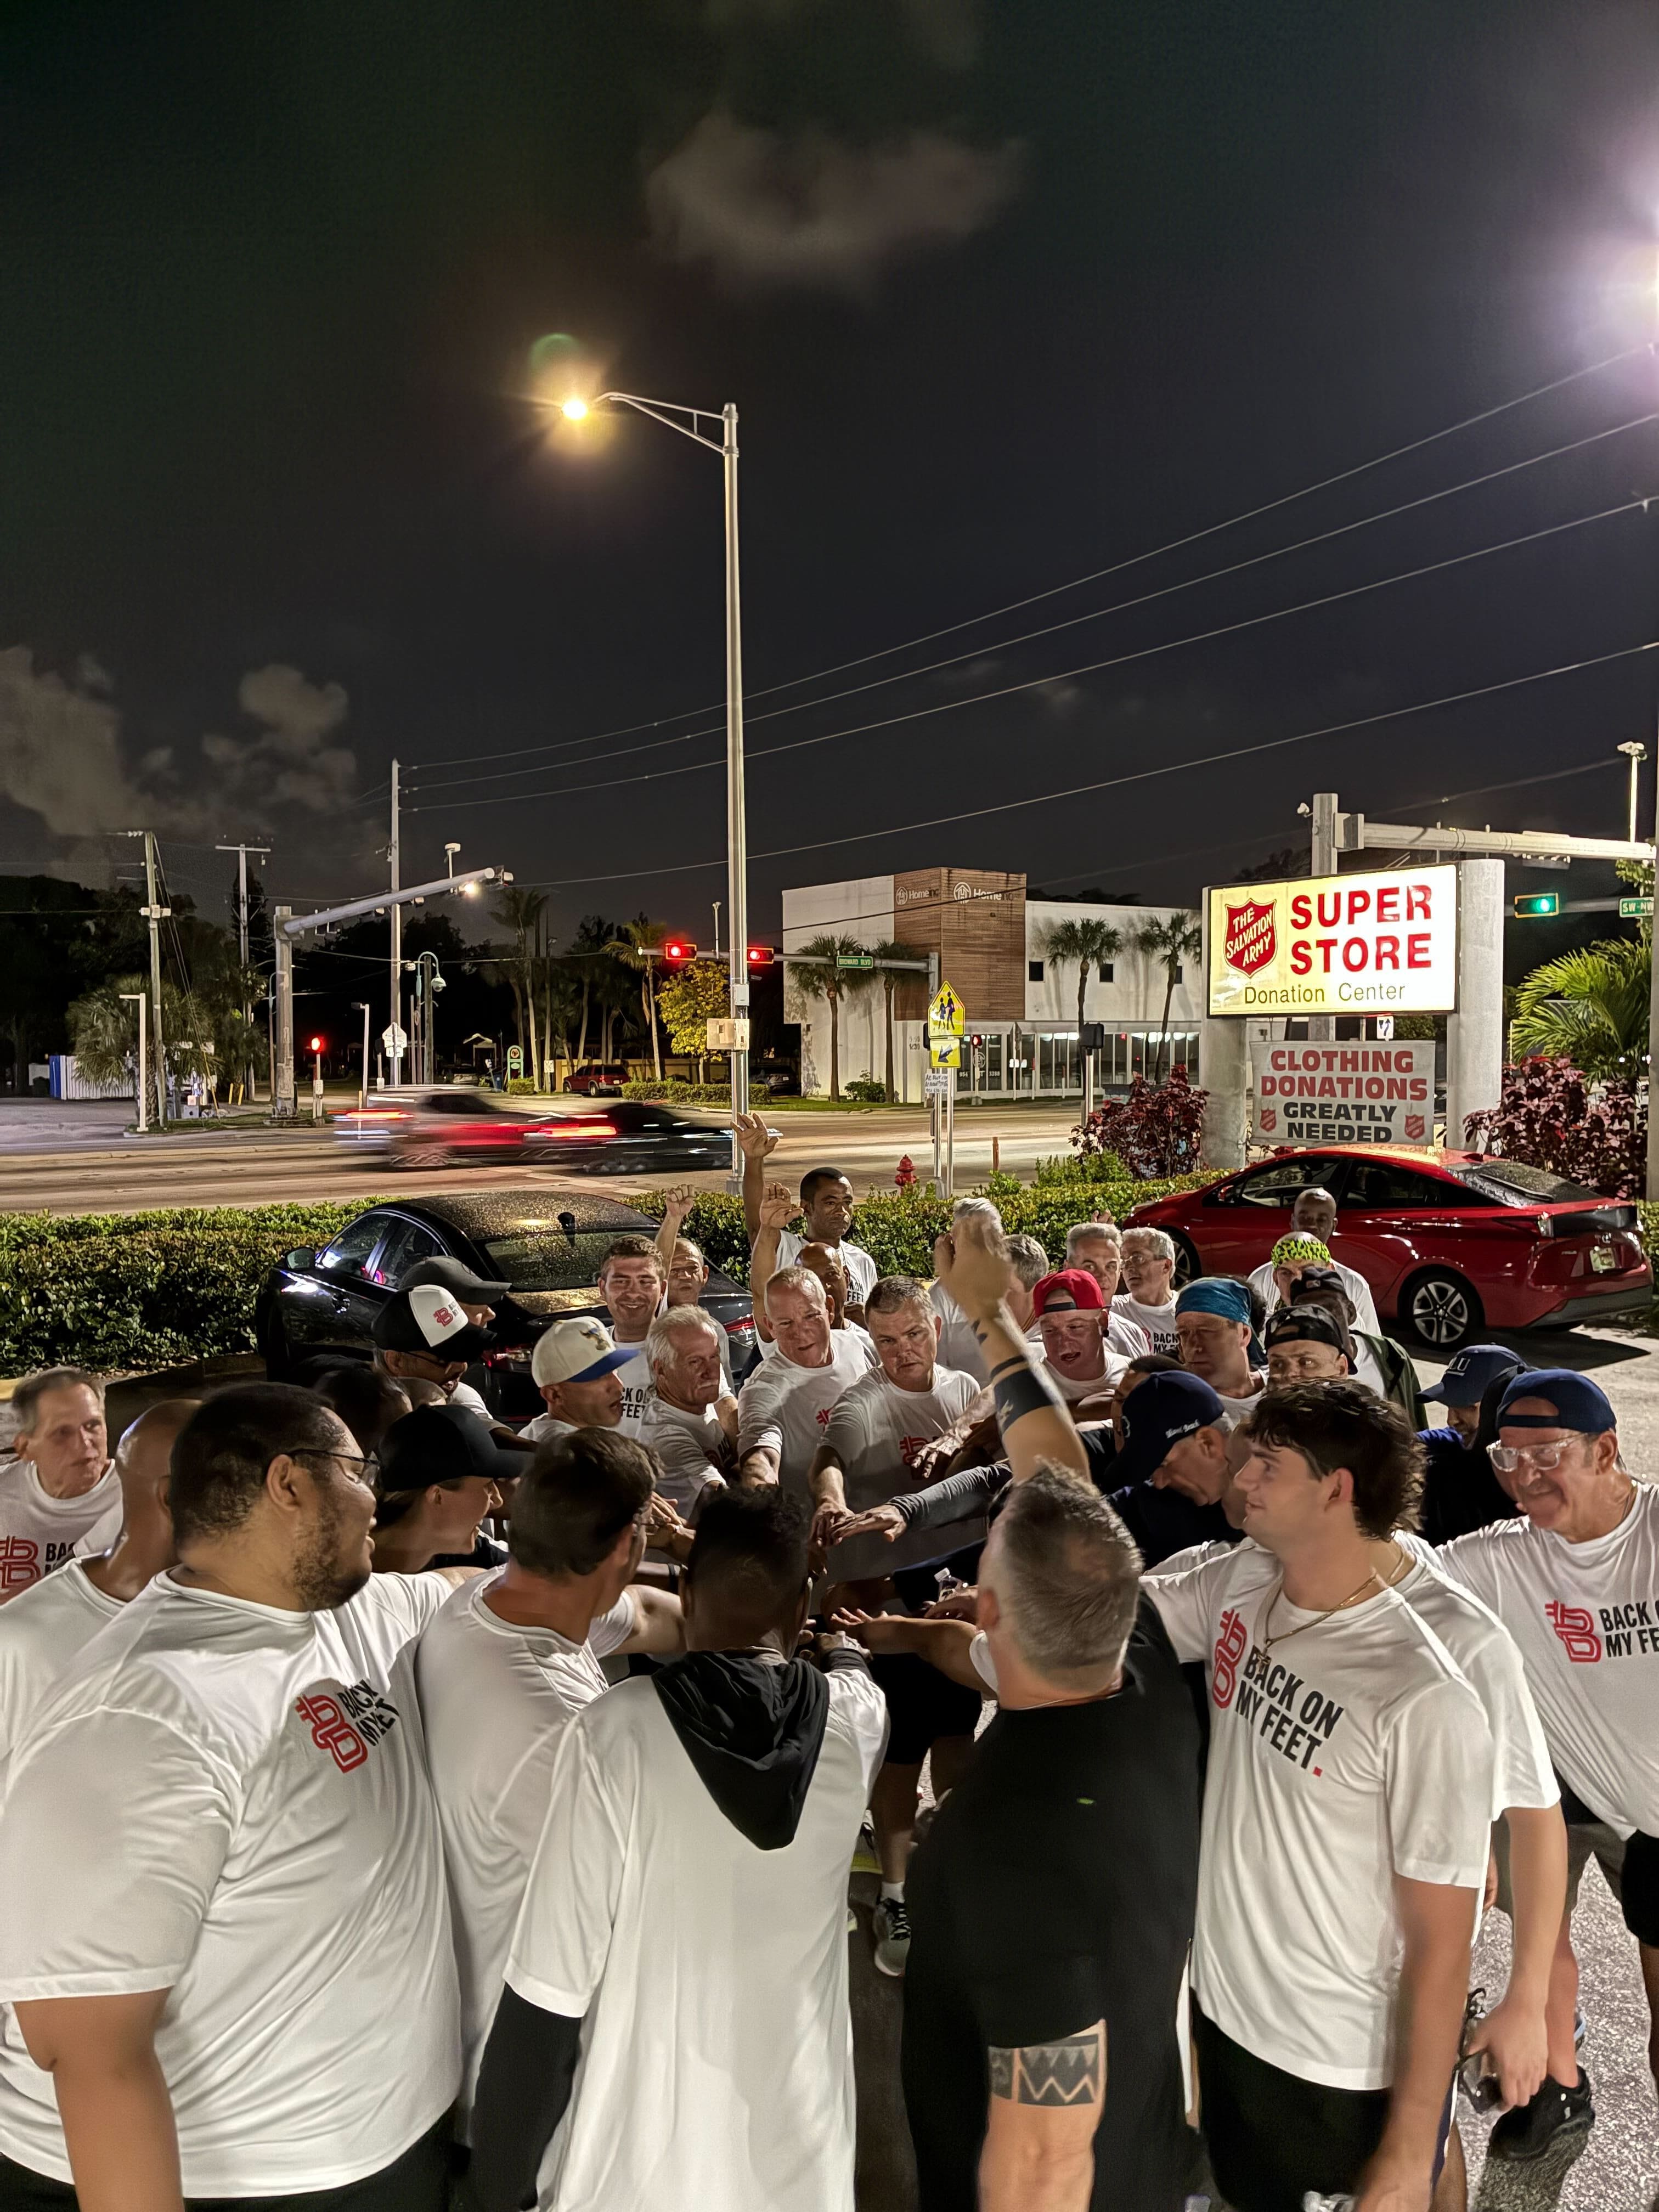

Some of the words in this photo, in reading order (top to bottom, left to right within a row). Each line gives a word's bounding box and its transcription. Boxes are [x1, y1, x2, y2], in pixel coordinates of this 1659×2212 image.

[1233, 907, 1255, 933] THE
[1290, 884, 1432, 929] SUPER
[1226, 909, 1272, 959] SALVATION
[1242, 932, 1272, 967] ARMY
[1290, 933, 1432, 975] STORE
[1245, 984, 1325, 1003] Donation
[1339, 983, 1406, 1001] Center
[1271, 1050, 1414, 1073] CLOTHING
[1261, 1076, 1427, 1101] DONATIONS
[1283, 1102, 1397, 1122] GREATLY
[1288, 1122, 1392, 1143] NEEDED
[1599, 1601, 1652, 1633] BACK
[1605, 1631, 1632, 1658] MY
[1637, 1627, 1659, 1654] FE
[1235, 1680, 1265, 1725] MY
[1244, 1645, 1305, 1712] BACK
[1300, 1691, 1344, 1739] ON
